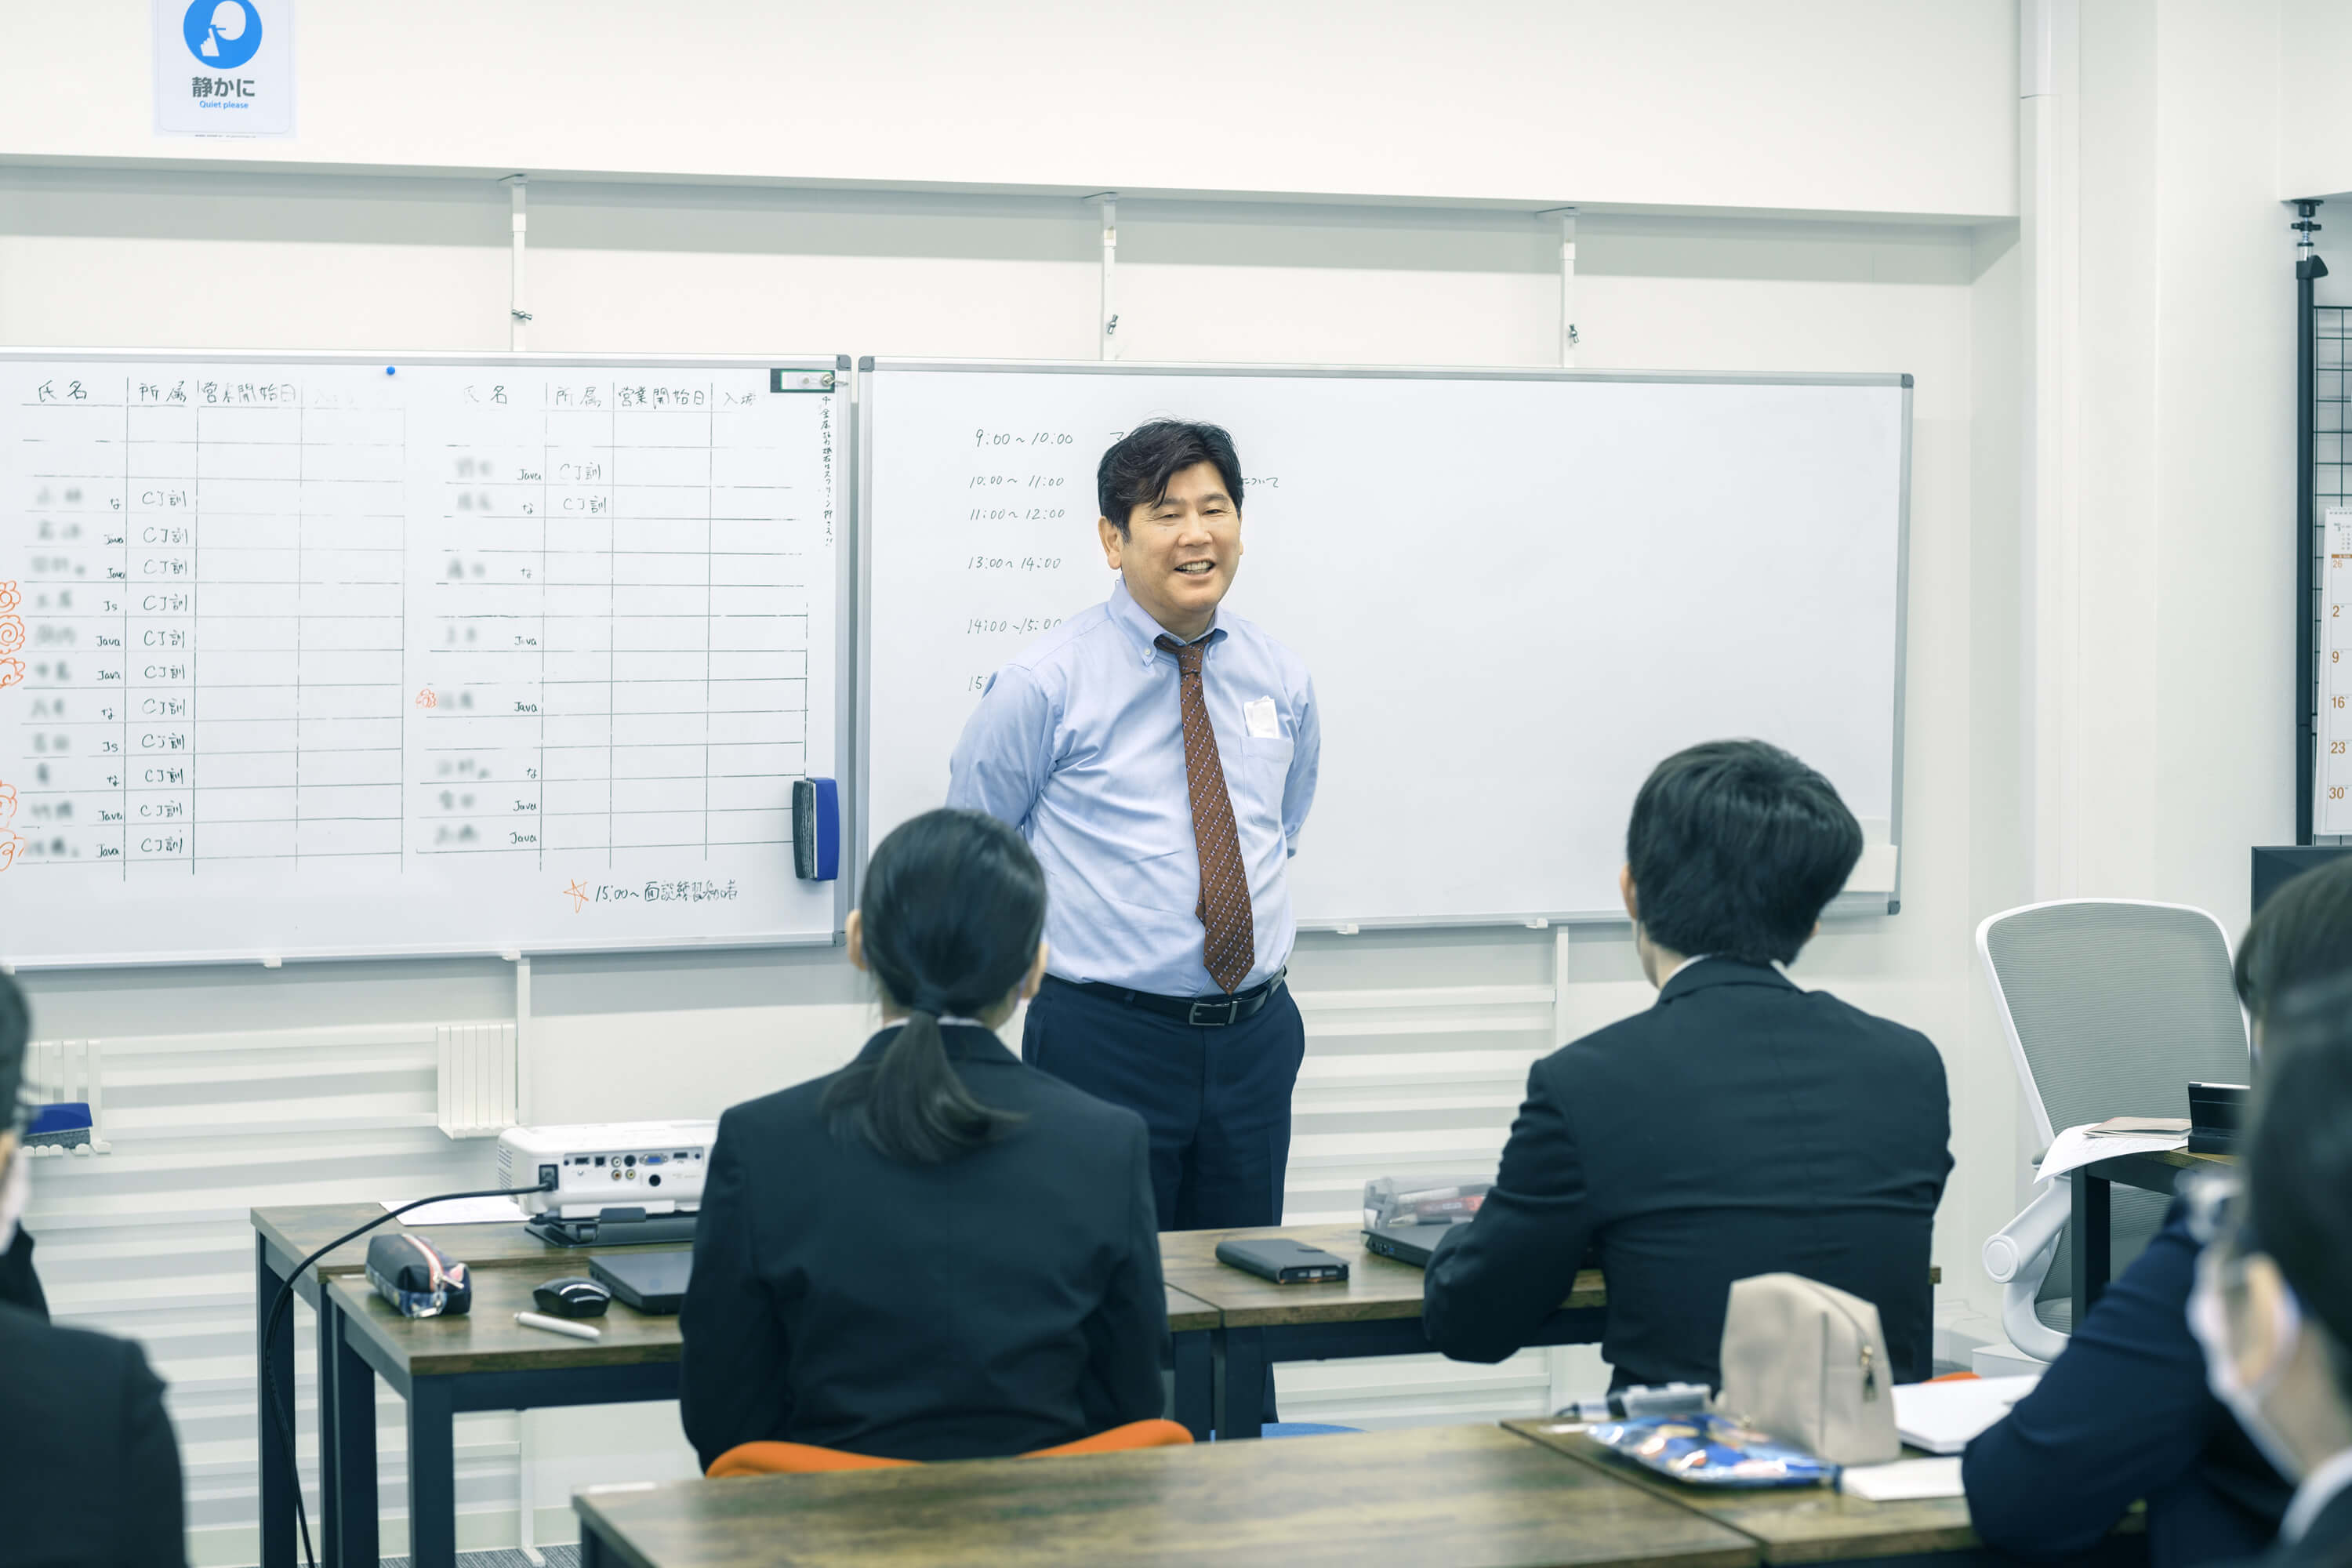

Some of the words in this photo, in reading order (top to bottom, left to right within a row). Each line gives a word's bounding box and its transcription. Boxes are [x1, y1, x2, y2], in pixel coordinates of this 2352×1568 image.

[191, 77, 255, 97] 静かに
[223, 101, 249, 110] please
[517, 469, 542, 483] Java
[2333, 605, 2339, 617] 2
[514, 635, 538, 646] Jva
[2332, 651, 2339, 663] 9
[2332, 696, 2345, 709] 16
[2331, 742, 2345, 753] 23
[2328, 786, 2345, 800] 30
